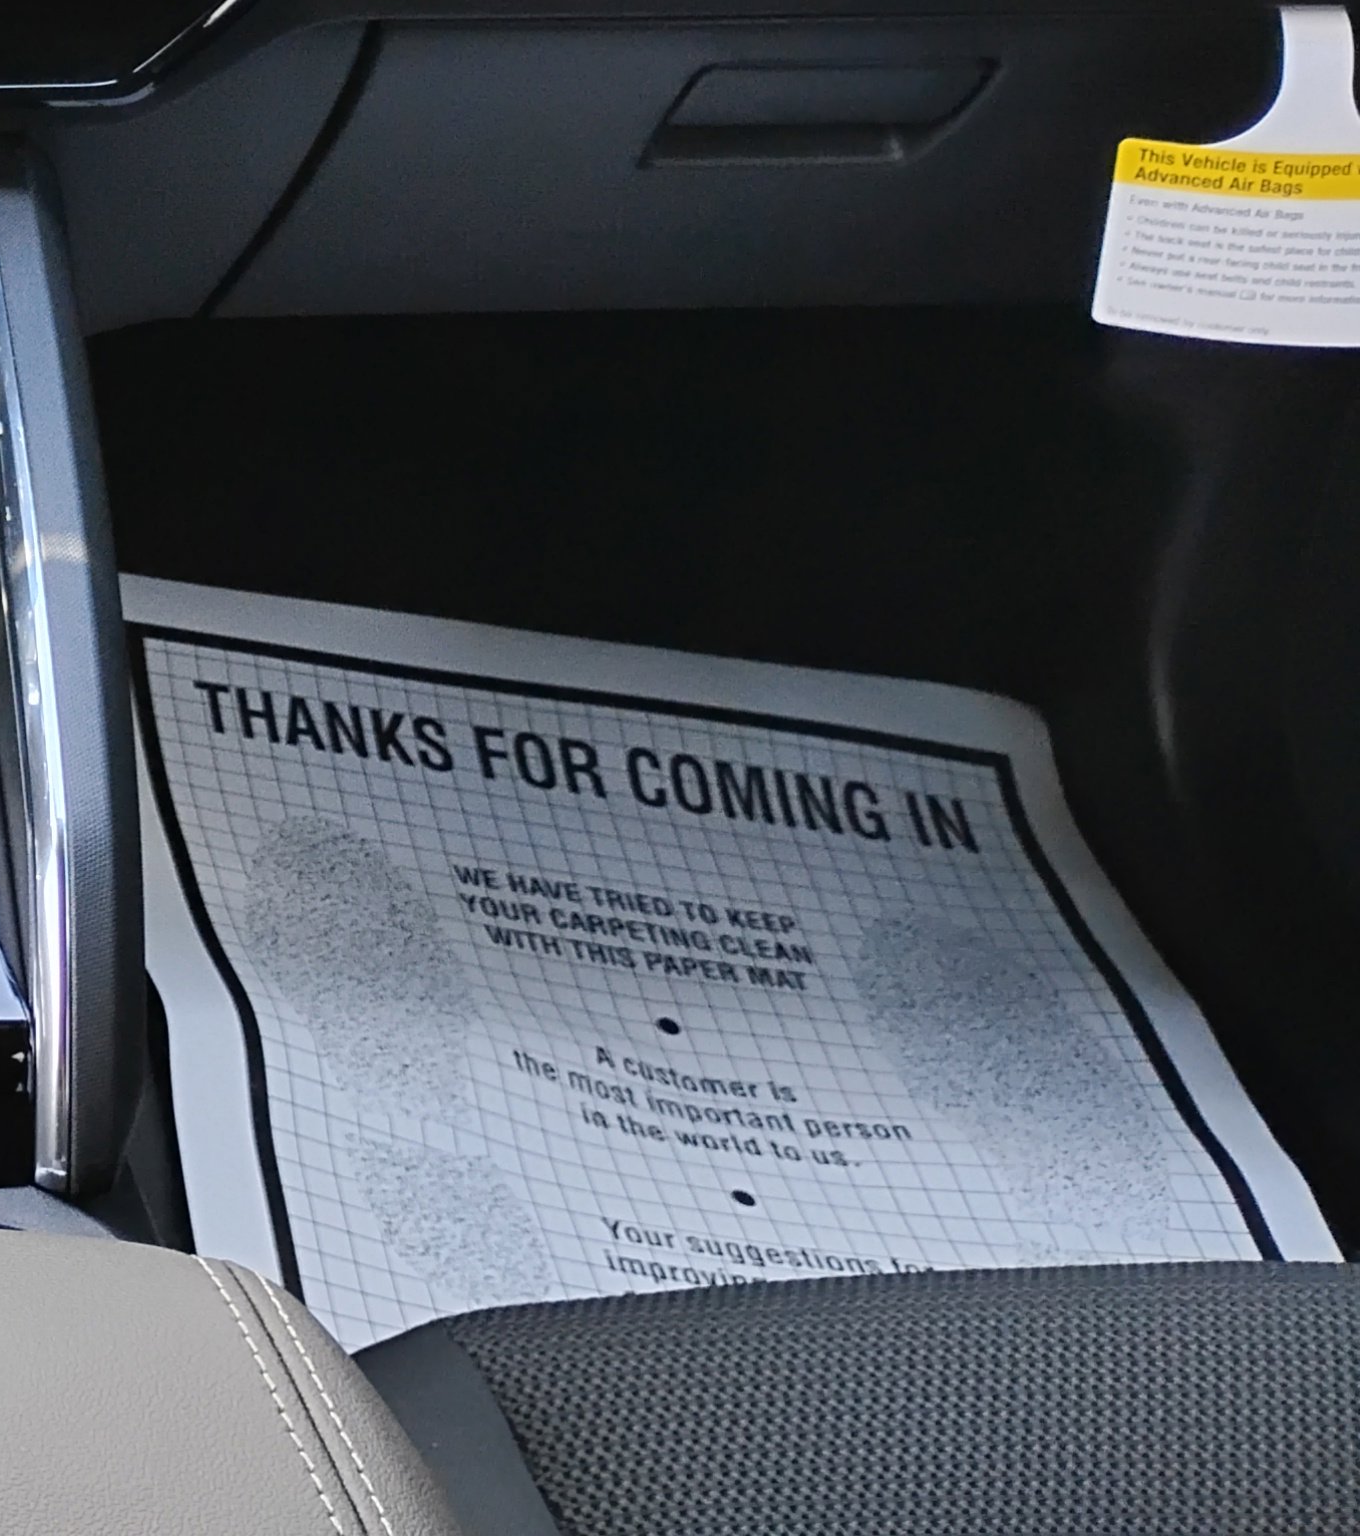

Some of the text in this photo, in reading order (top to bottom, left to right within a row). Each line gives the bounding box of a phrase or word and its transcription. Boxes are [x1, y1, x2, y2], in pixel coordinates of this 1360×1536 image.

[1134, 166, 1303, 198] Advanced Air Bags
[1139, 147, 1175, 166] This
[1182, 152, 1247, 173] Vehicle
[1252, 160, 1267, 175] is
[1273, 160, 1352, 179] Equipped
[194, 681, 980, 855] THANKS FOR COMING IN
[452, 865, 797, 935] WE HAVE TRIED TO KEEP
[458, 893, 814, 965] YOUR CARPETING CLEAN
[484, 924, 808, 991] WITH THIS PAPER MAT
[512, 1049, 912, 1142] the most important person
[595, 1045, 797, 1104] A customer is
[581, 1099, 862, 1168] in the world to us.
[601, 1216, 676, 1250] Your
[685, 1231, 883, 1274] suggestions
[605, 1249, 767, 1286] improvin
